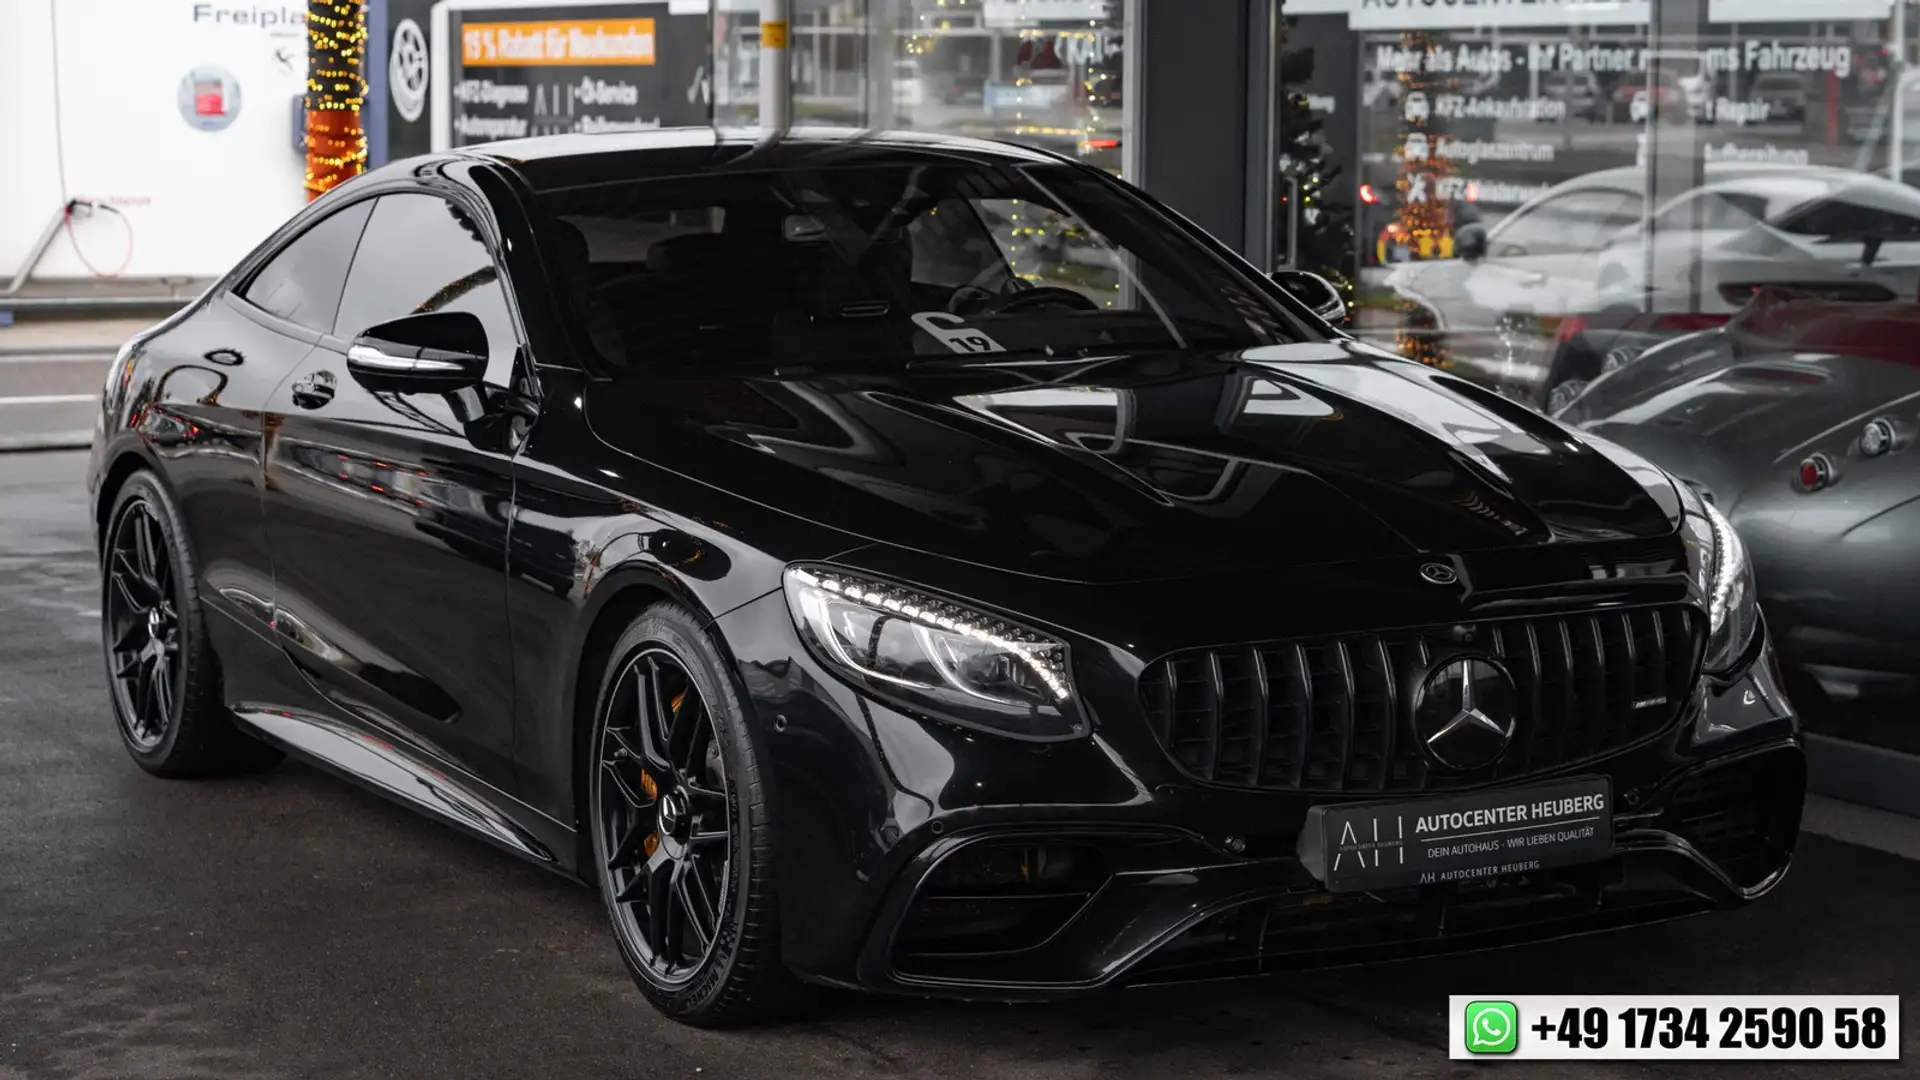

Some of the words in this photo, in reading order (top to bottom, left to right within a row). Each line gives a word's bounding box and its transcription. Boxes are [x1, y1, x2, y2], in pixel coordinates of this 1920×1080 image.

[1744, 40, 1851, 78] Fahrzeug
[1415, 804, 1528, 833] AUTOCENTER
[1531, 794, 1604, 819] HEUBERG
[1427, 847, 1450, 859] DEIN
[1450, 839, 1500, 856] AUTOHAUS
[1507, 837, 1525, 849] WIR
[1527, 832, 1556, 847] LIEBEN
[1556, 826, 1595, 842] QUALITÄT
[1440, 865, 1499, 881] AUTOCENTER
[1501, 860, 1540, 873] HEUBERG
